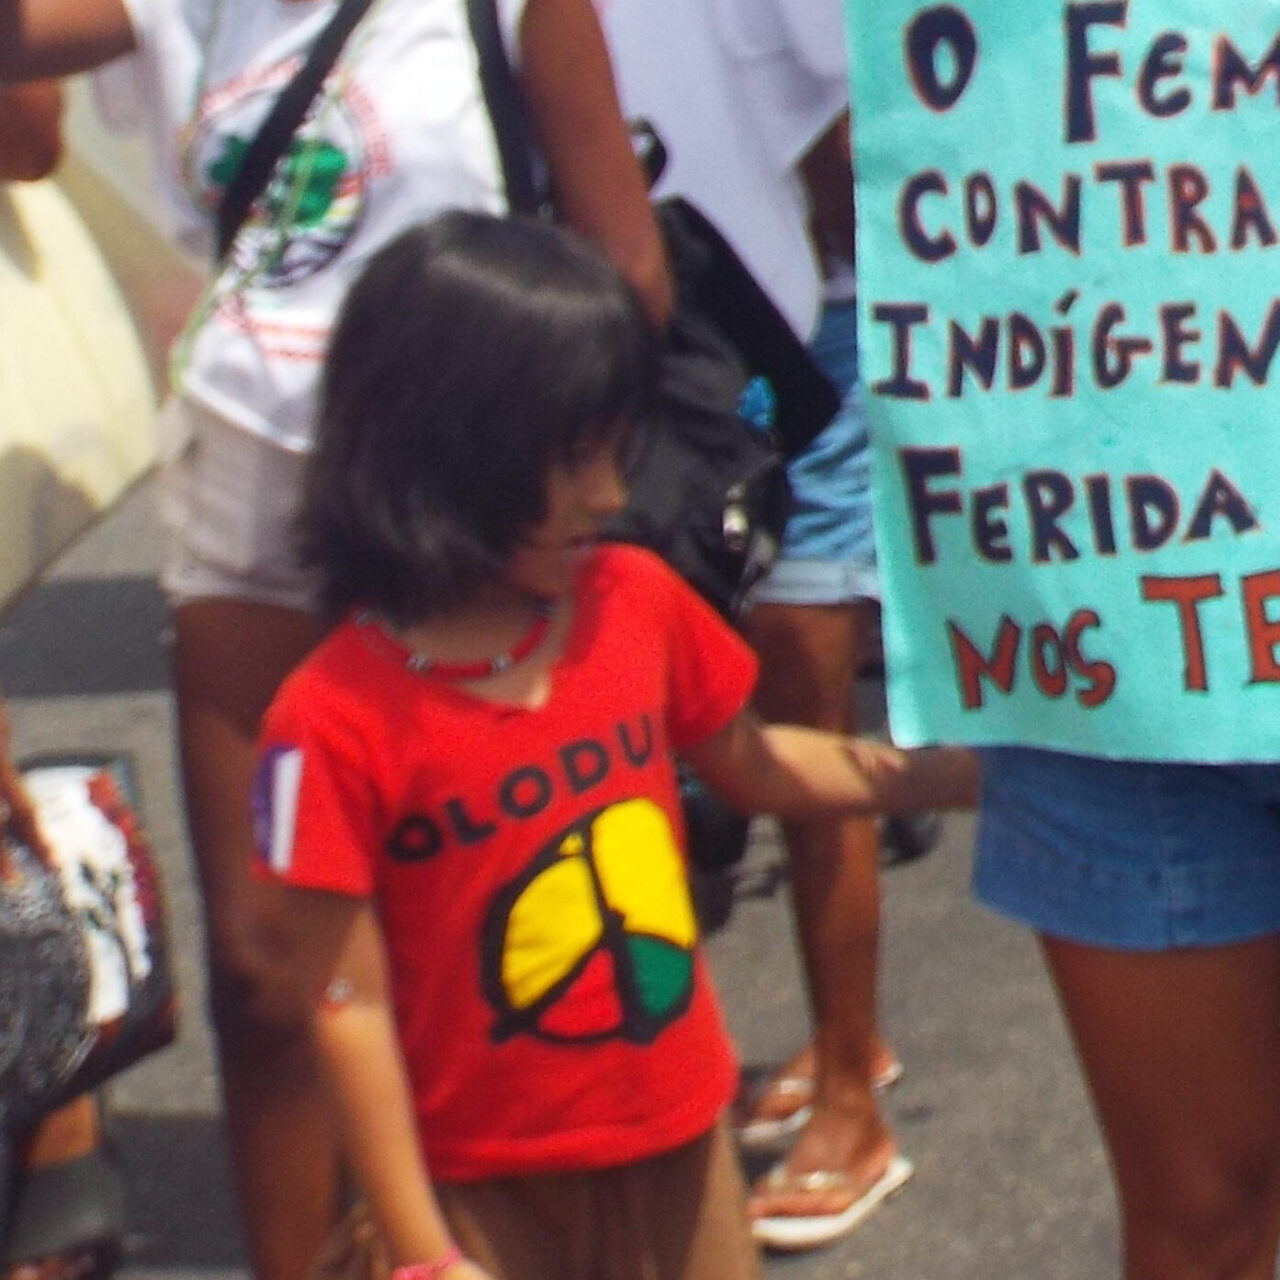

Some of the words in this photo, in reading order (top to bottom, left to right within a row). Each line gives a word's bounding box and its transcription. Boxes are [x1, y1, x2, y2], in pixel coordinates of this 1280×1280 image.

[903, 3, 980, 114] O
[898, 159, 1279, 265] CONTRA
[896, 445, 1260, 569] FERIDA
[944, 607, 1119, 713] NOS
